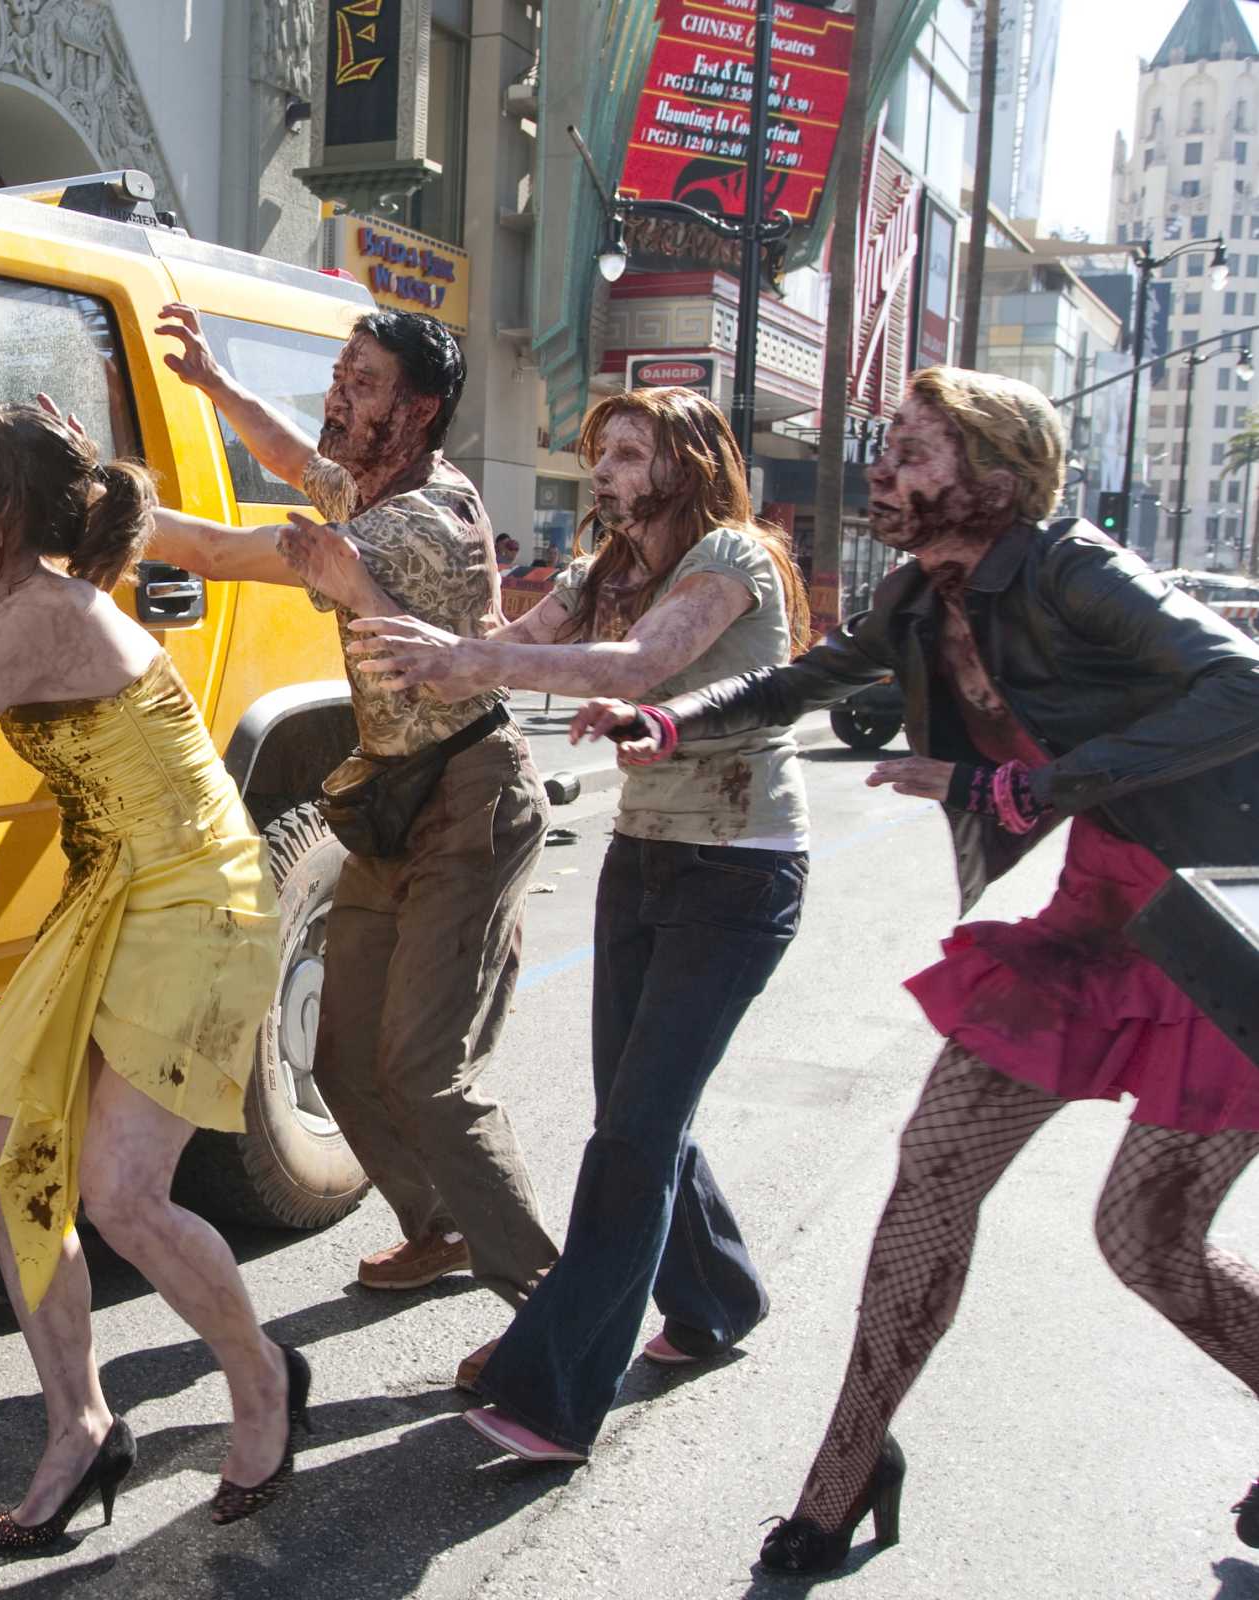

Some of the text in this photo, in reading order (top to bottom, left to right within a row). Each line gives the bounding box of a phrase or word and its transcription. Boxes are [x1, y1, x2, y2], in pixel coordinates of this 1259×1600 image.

[681, 13, 745, 42] CHINESE
[769, 31, 816, 57] heatres
[693, 53, 720, 78] Fast
[720, 58, 734, 82] &
[655, 100, 714, 134] Haunting
[715, 111, 730, 132] In
[643, 367, 700, 379] DANGER
